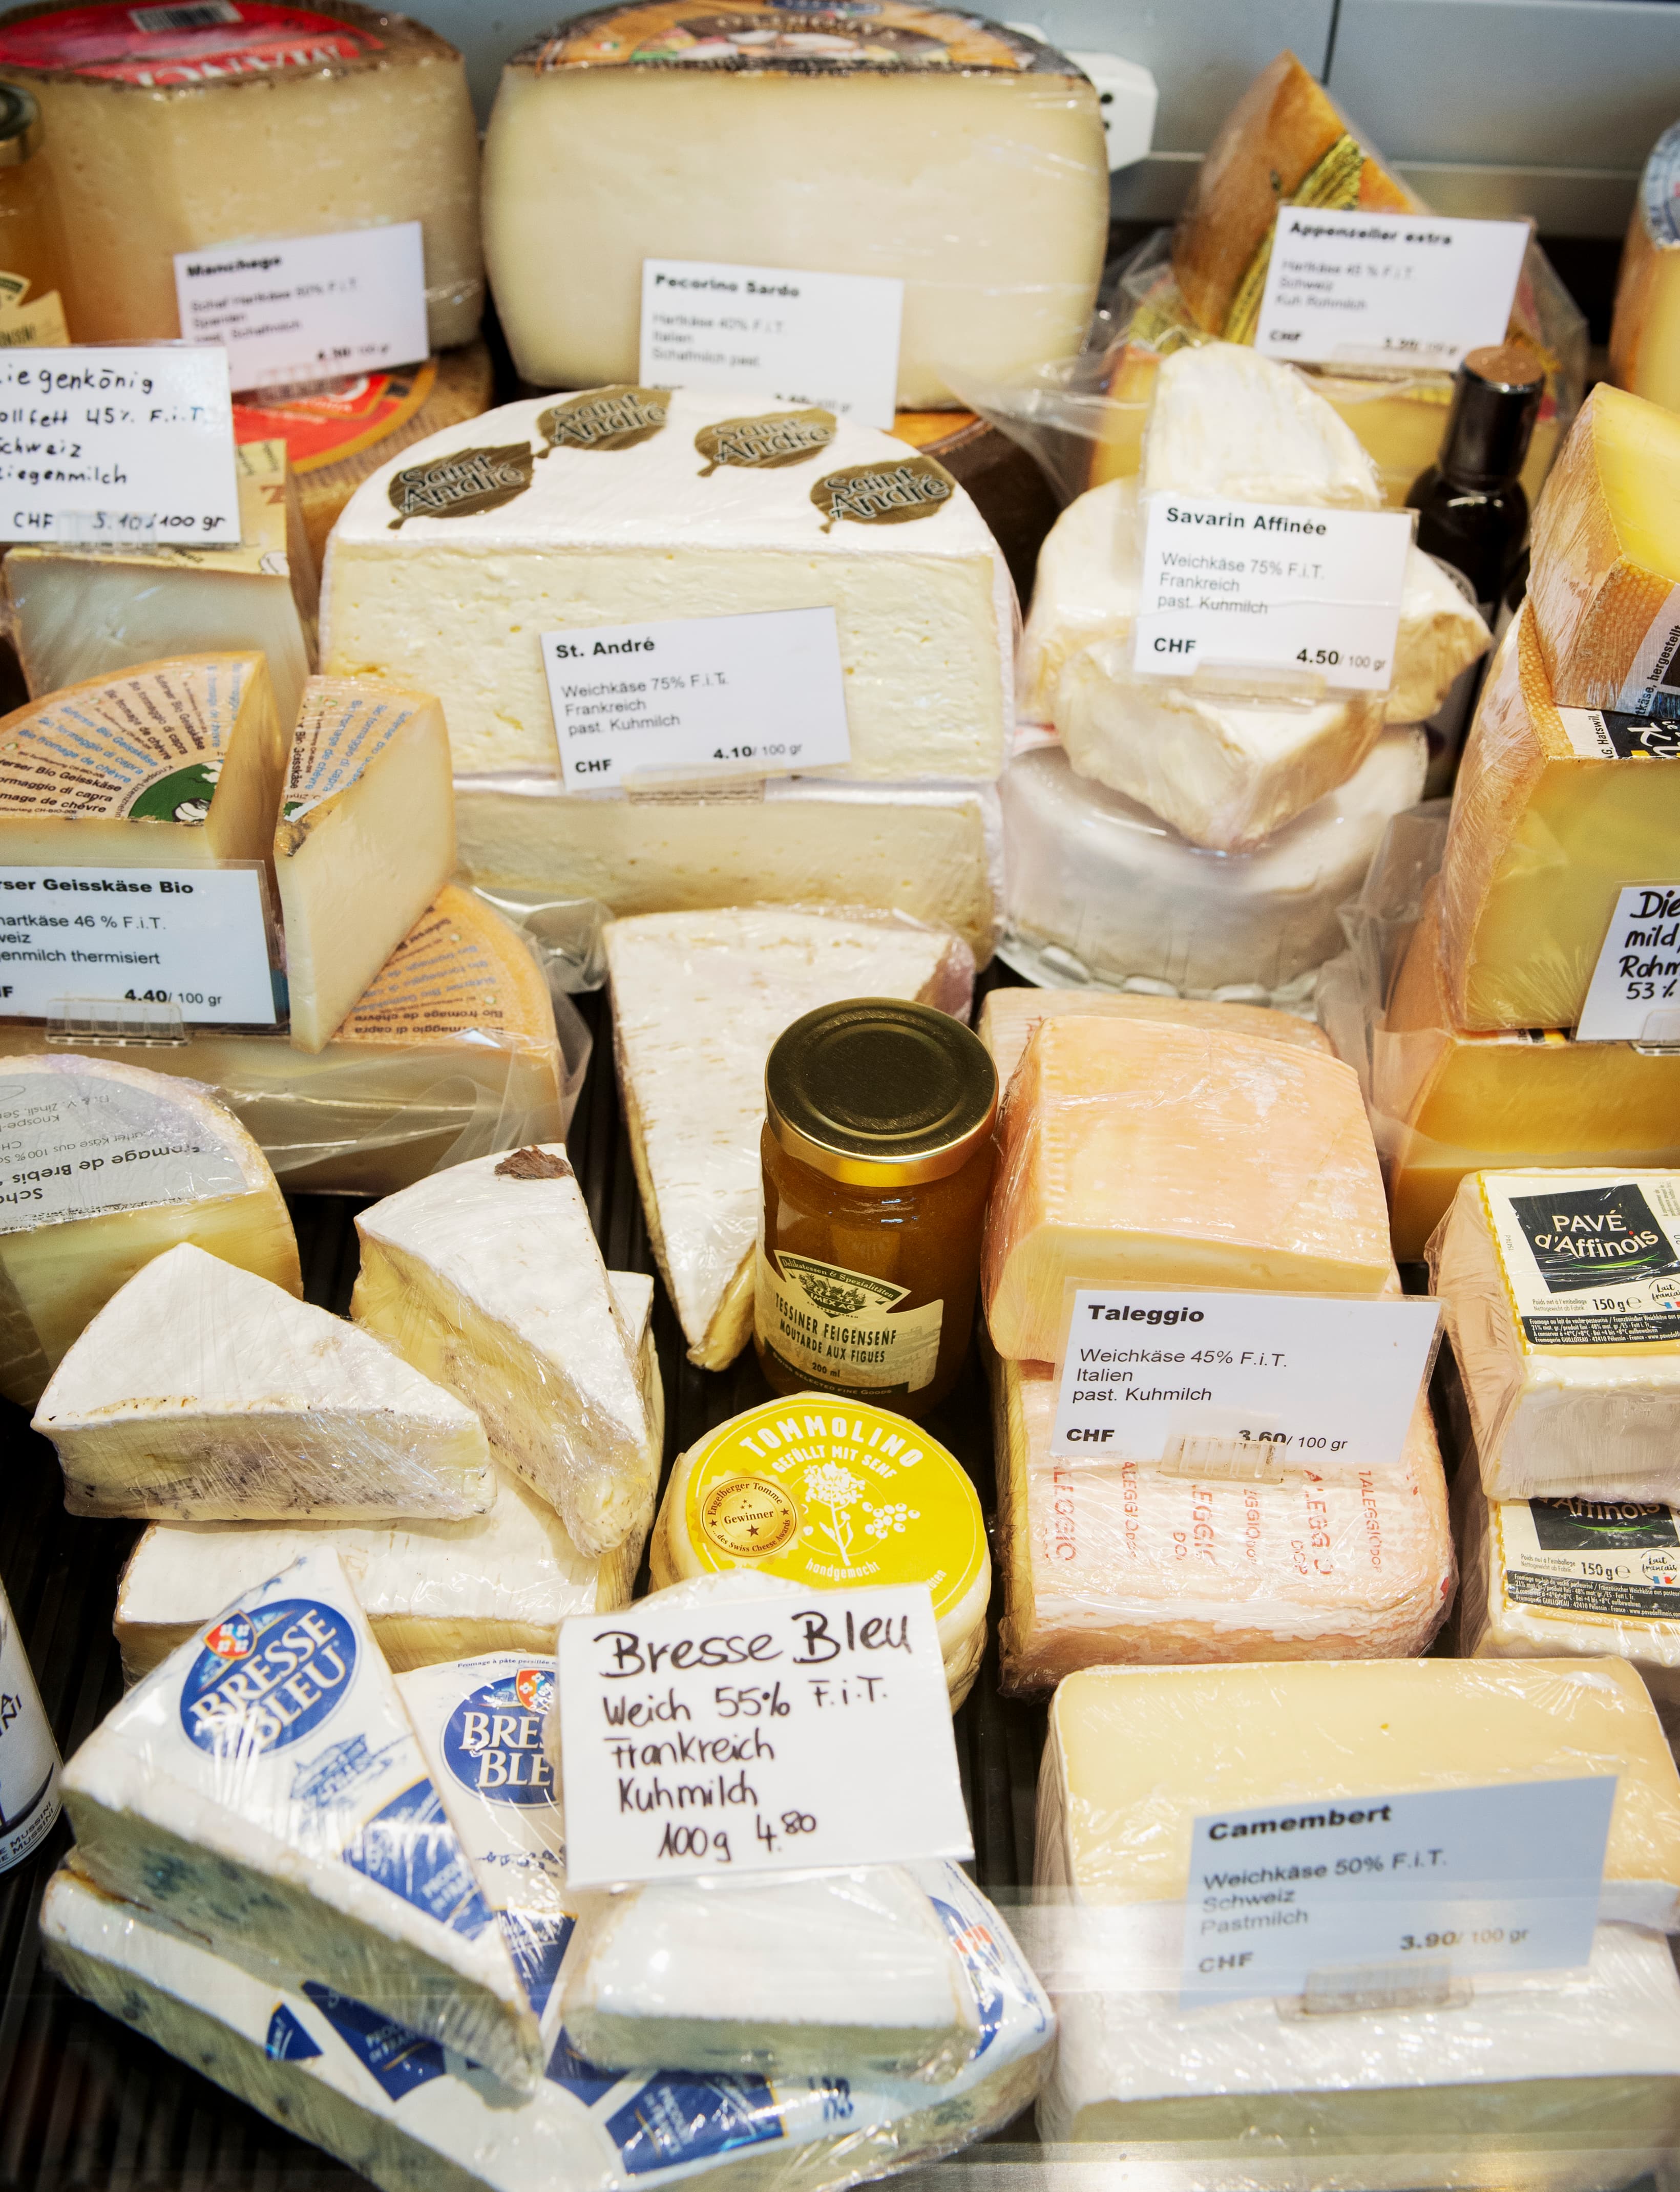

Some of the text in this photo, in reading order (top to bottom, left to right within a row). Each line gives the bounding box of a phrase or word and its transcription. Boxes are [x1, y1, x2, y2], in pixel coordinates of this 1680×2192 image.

[655, 273, 801, 298] Pecorino Sardo
[398, 454, 496, 487] Saint
[824, 466, 917, 495] Saint
[398, 463, 524, 514] André
[829, 474, 951, 520] André
[13, 512, 54, 528] CHF
[1167, 508, 1327, 536] Savarin Affinée
[1162, 552, 1325, 580] Weichkäse 75% F.i.T.
[1160, 572, 1240, 592] Frankreich
[1199, 596, 1269, 615] Kuhmilch
[556, 636, 656, 659] St. André
[1153, 637, 1196, 654] CHF
[561, 680, 646, 698] Weichkäse
[650, 676, 686, 691] 75%
[565, 699, 646, 718] Frankreich
[610, 714, 681, 733] Kuhmilch
[575, 758, 612, 774] CHF
[762, 744, 786, 756] 100
[35, 766, 122, 792] Bio Geisskäse
[40, 797, 57, 806] de
[59, 786, 113, 803] di capra
[43, 878, 194, 894] Geisskäse Bio
[74, 915, 166, 930] 46 % F.i.T.
[71, 950, 161, 965] thermisiert
[178, 993, 203, 1004] 100
[208, 994, 222, 1007] gr
[54, 1142, 76, 1153] aus
[79, 1135, 110, 1149] Käse
[12, 1157, 104, 1184] de Brebis
[1551, 1209, 1627, 1233] PAVÉ
[1535, 1229, 1660, 1260] d'Affinois
[781, 1257, 895, 1299] Delikatessen & Spezialitäten
[1656, 1283, 1676, 1294] Lait
[810, 1292, 836, 1306] IMEX
[838, 1301, 856, 1311] AG
[1592, 1298, 1626, 1313] 150 g
[775, 1292, 818, 1333] TESSINER
[823, 1322, 897, 1346] FEIGENSENF
[1087, 1304, 1205, 1326] Taleggio
[779, 1318, 885, 1363] MOUTARDE AUX FIGUES
[811, 1362, 841, 1378] 200 ml
[1079, 1348, 1288, 1368] Weichkäse 45% F.i.T.
[1076, 1368, 1133, 1382] Italien
[1073, 1387, 1212, 1404] past. Kuhmilch
[739, 1415, 924, 1469] TOMMOLINO
[1066, 1428, 1115, 1443] CHF
[1298, 1437, 1327, 1449] 100
[1330, 1438, 1349, 1452] gr
[771, 1444, 898, 1480] GEFÜLLT MIT SENF
[707, 1481, 784, 1516] Engelberger Tomme
[723, 1508, 774, 1525] Gewinner
[728, 1518, 792, 1554] Swiss Cheese Awards
[805, 1557, 882, 1583] handgemacht
[1581, 1562, 1613, 1580] 150 g
[1648, 1556, 1667, 1565] Lait
[457, 1659, 491, 1668] Fromage
[593, 1630, 784, 1679] Bresse
[189, 1608, 338, 1732] BRESSE
[250, 1646, 349, 1752] BLEU
[602, 1688, 692, 1728] Weich
[716, 1681, 791, 1718] 55%
[603, 1727, 775, 1770] Frankreich
[476, 1751, 552, 1788] BLE
[618, 1769, 759, 1814] Kuhmilch
[1208, 1803, 1393, 1842] Camembert
[1203, 1849, 1448, 1891] Weichkäse 50% F.i.T.
[1202, 1889, 1296, 1913] Schweiz
[1200, 1909, 1309, 1936] Pastmilch
[1199, 1952, 1254, 1974] CHF
[1472, 1929, 1505, 1944] 100
[1509, 1928, 1529, 1944] gr
